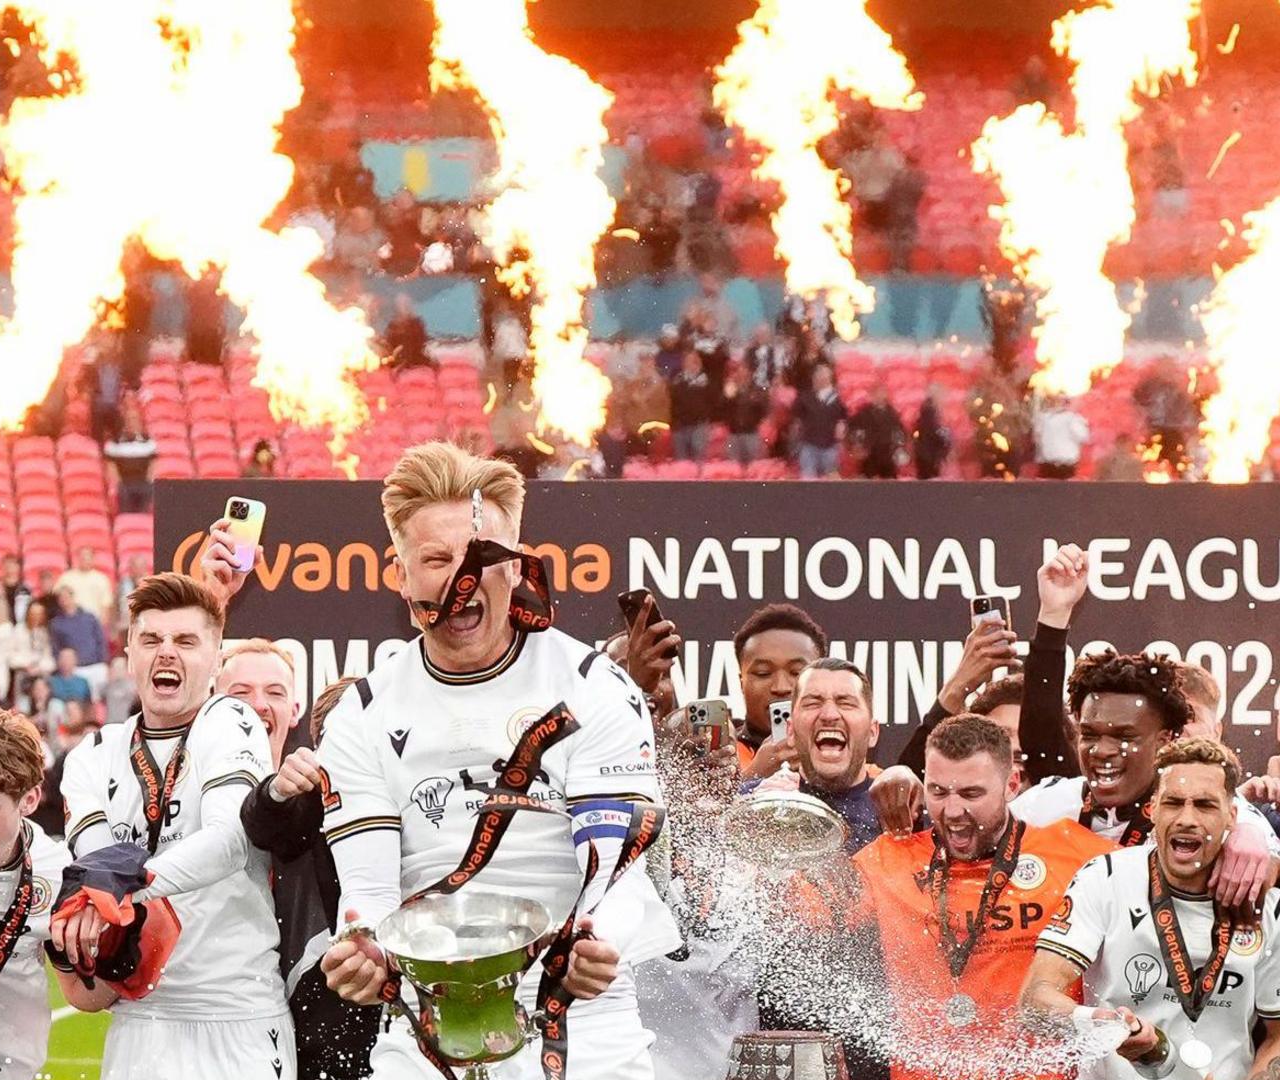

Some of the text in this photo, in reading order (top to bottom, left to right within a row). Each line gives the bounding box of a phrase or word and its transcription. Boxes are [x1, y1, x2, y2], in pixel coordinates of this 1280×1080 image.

[255, 543, 611, 592] vanma
[629, 536, 1020, 601] NATIONAL
[134, 750, 159, 805] vanarama
[466, 789, 565, 811] REBLES
[1164, 924, 1193, 995] vanarama
[1163, 992, 1233, 1009] REBLES
